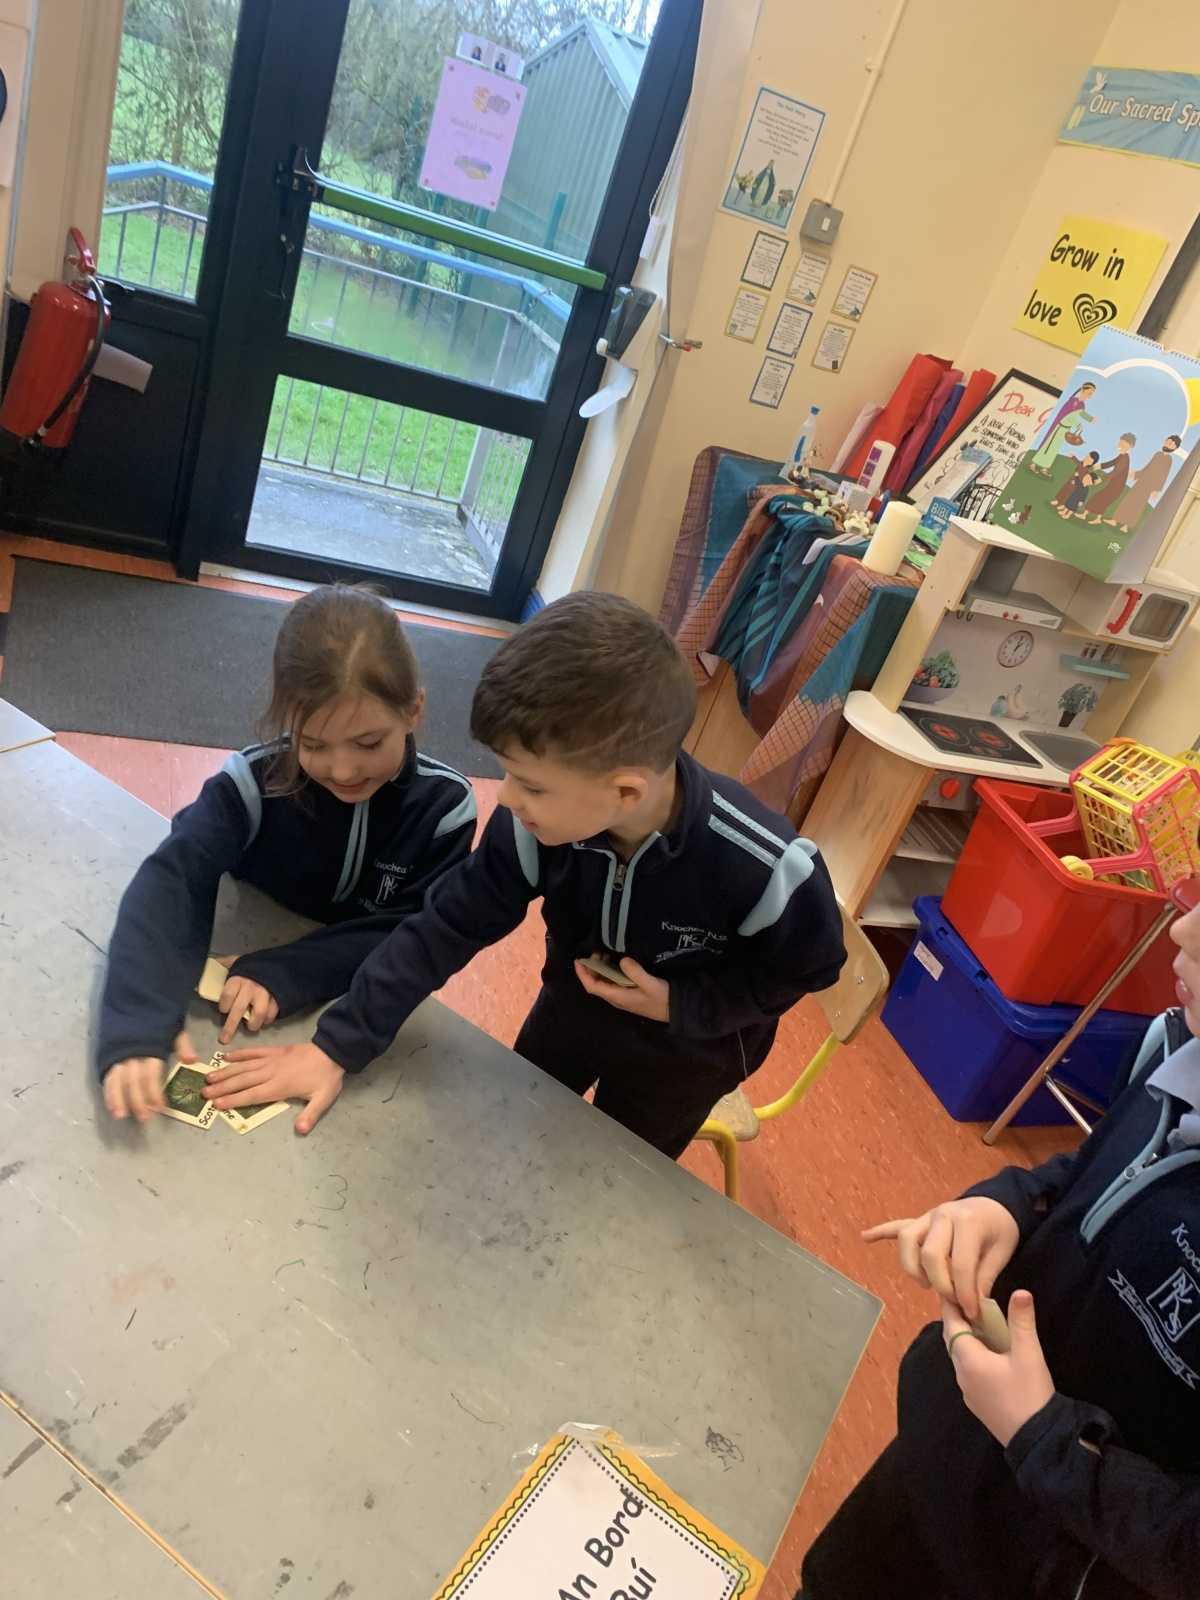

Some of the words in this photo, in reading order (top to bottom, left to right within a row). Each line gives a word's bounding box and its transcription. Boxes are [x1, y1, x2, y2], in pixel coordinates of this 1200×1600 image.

[1089, 94, 1120, 115] Our
[1120, 96, 1178, 122] Sacred
[1177, 103, 1200, 132] Sp
[1050, 233, 1099, 273] Grow
[1103, 247, 1125, 281] in
[1023, 288, 1062, 327] love
[1171, 1222, 1200, 1273] Knoc
[584, 1486, 645, 1568] Bord
